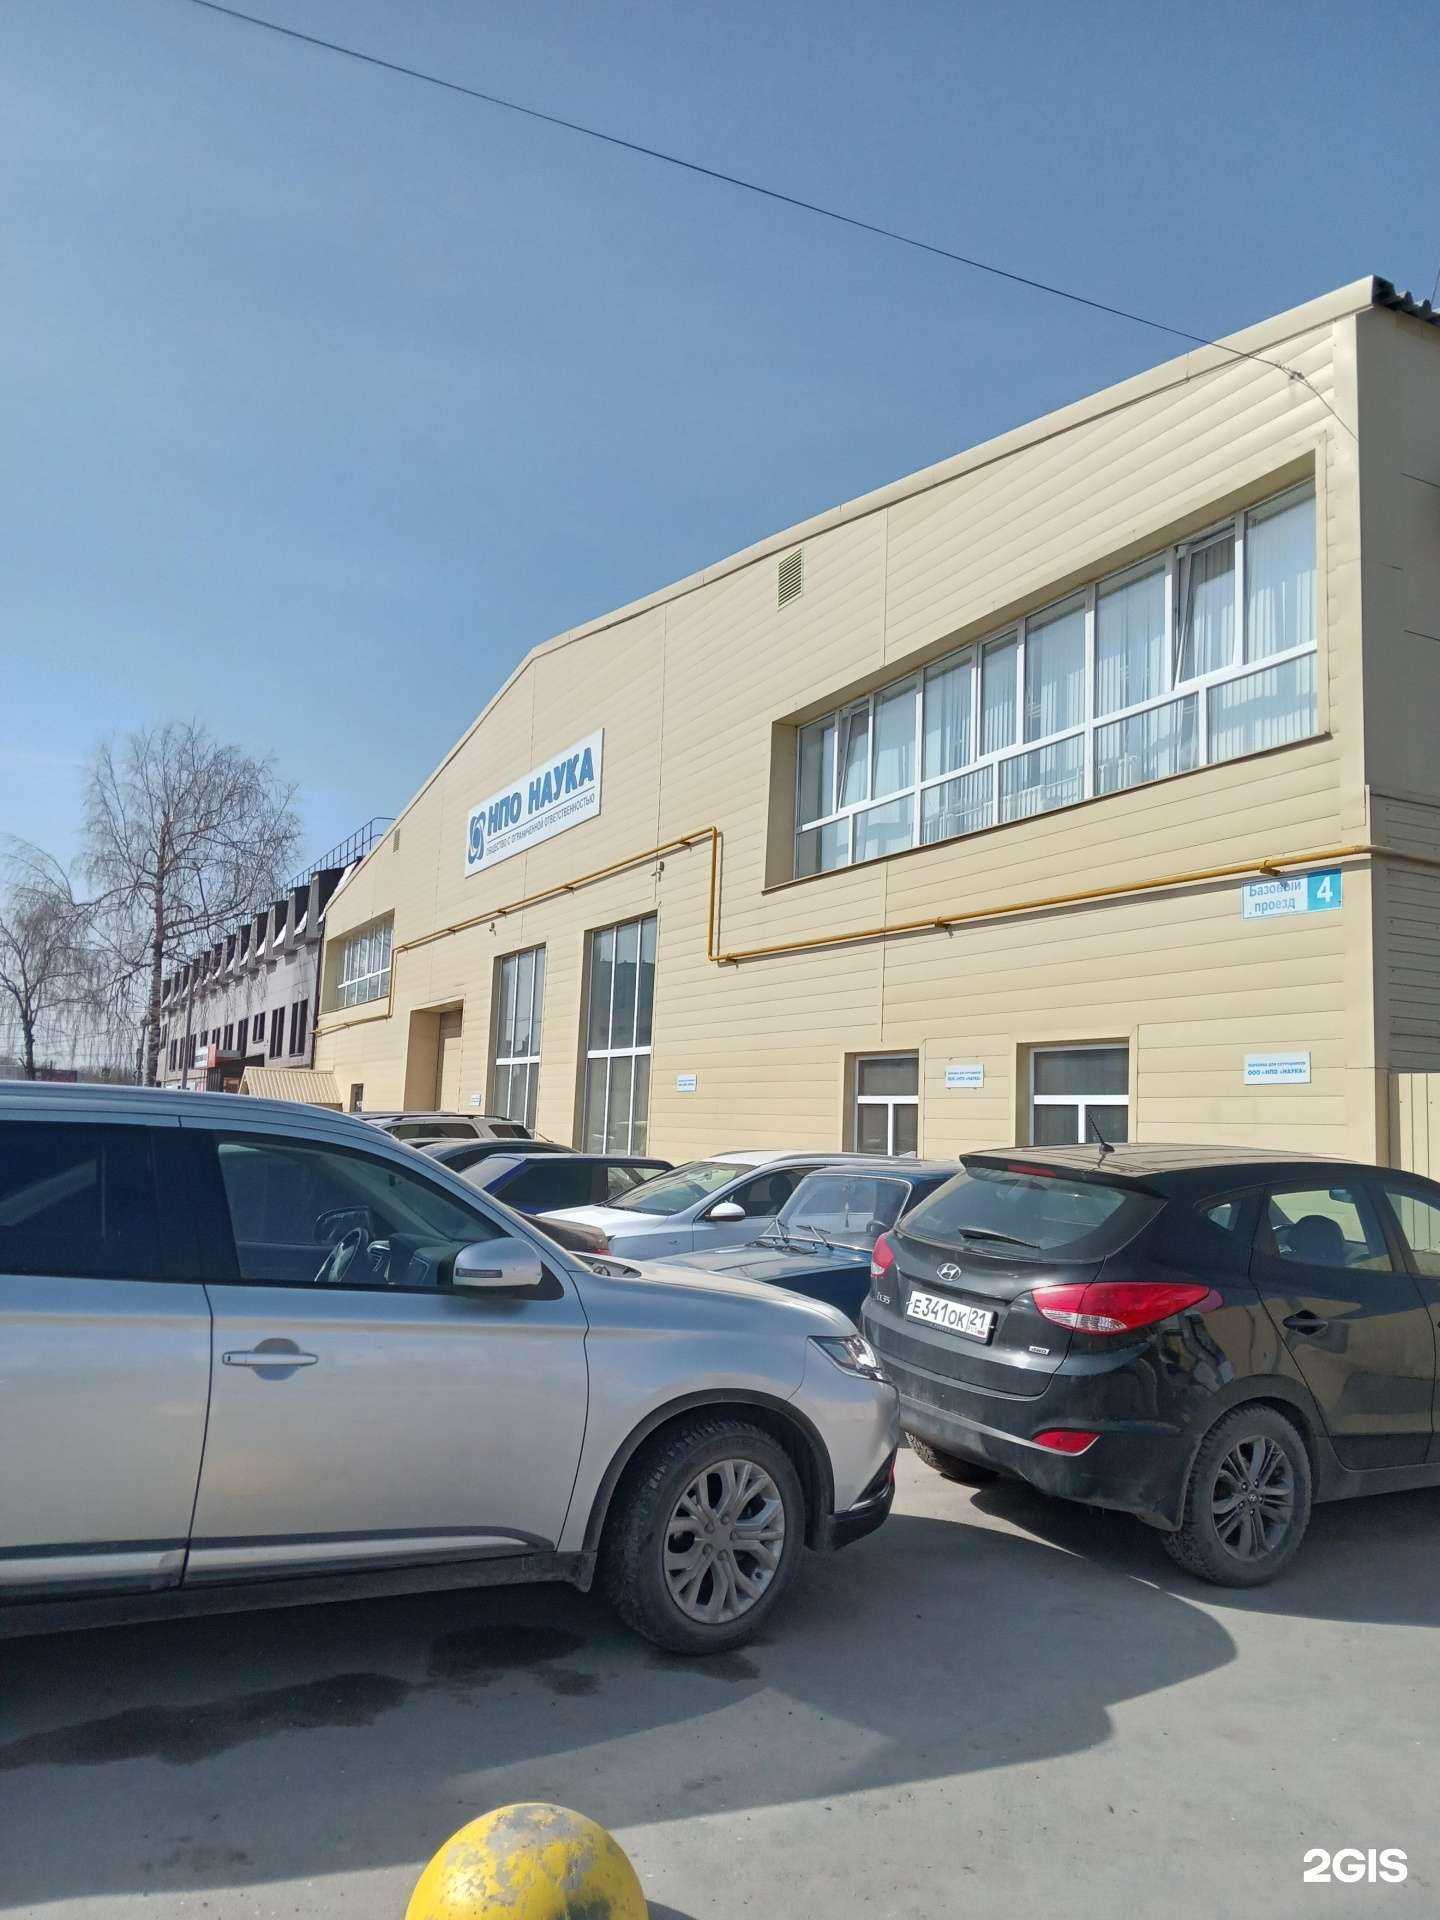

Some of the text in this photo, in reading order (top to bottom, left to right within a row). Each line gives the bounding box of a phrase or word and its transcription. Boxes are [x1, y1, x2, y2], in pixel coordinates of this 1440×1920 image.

[487, 747, 594, 836] НПО НАУКА
[1249, 879, 1301, 897] Базовый
[1317, 875, 1333, 902] 4
[1255, 898, 1295, 914] проезд
[970, 1310, 986, 1329] 21
